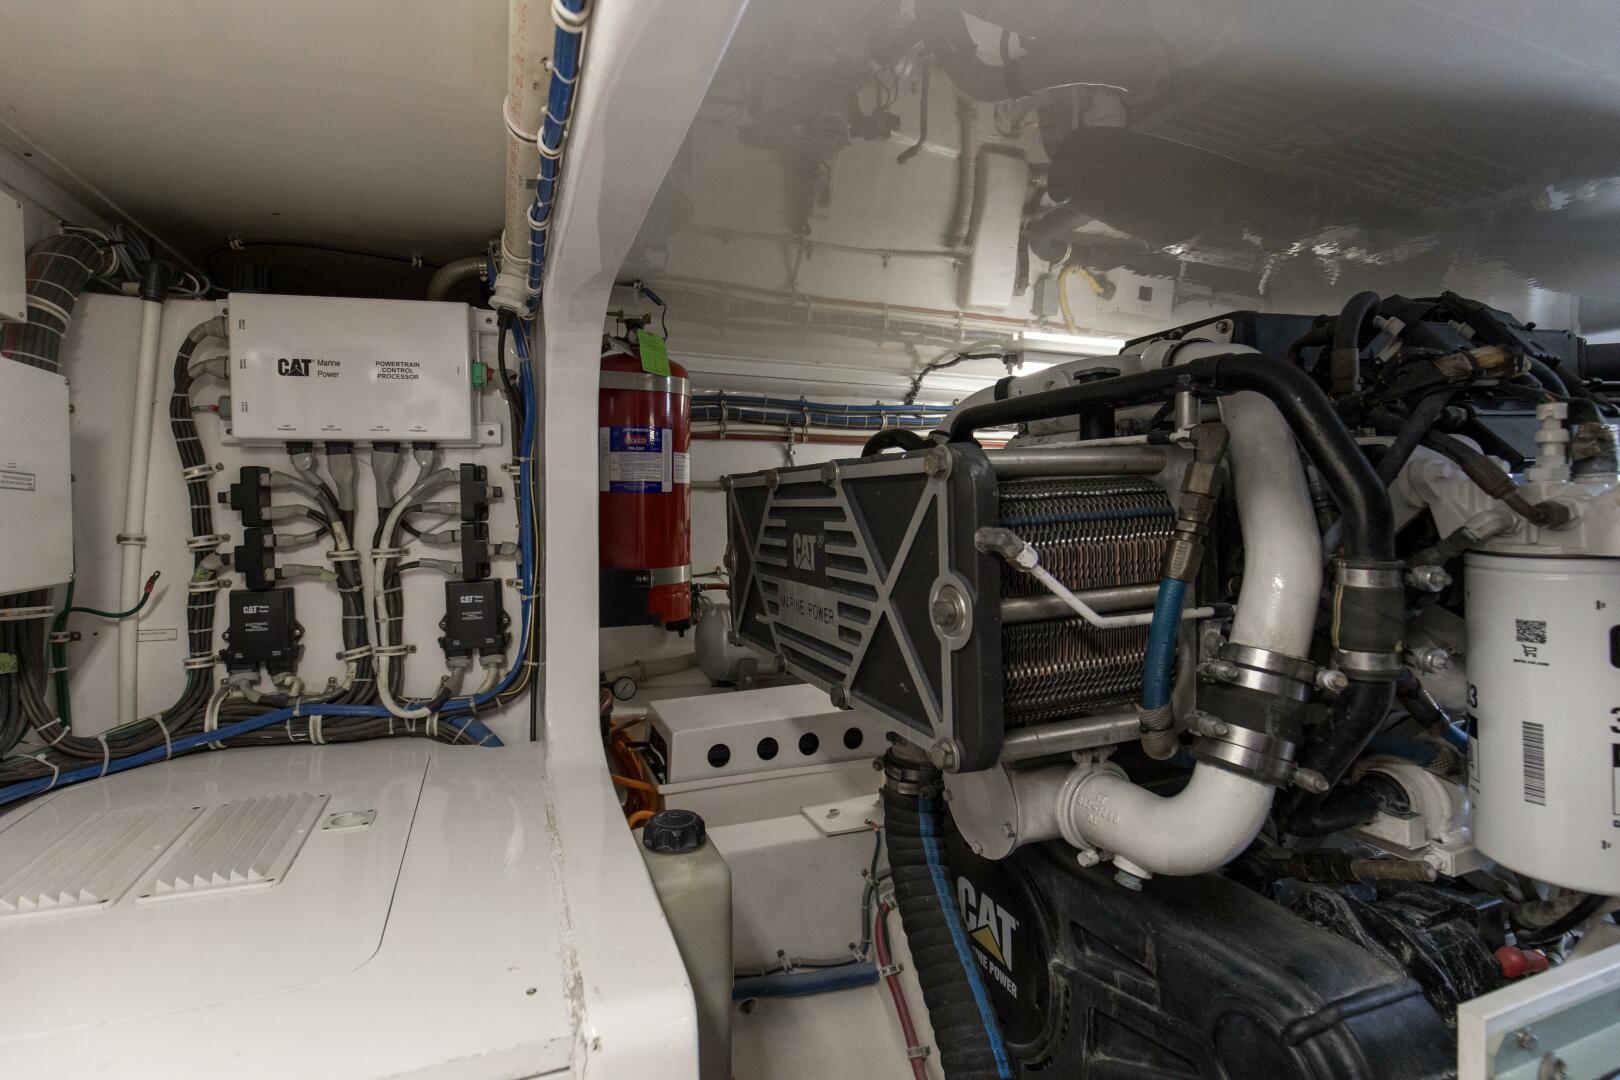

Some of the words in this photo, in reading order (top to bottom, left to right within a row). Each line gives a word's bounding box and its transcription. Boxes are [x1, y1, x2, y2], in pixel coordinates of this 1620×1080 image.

[277, 358, 312, 377] CAT
[317, 359, 341, 367] Marine
[375, 360, 420, 368] POWERTRAIN
[317, 370, 339, 378] Power
[460, 595, 473, 604] CAT
[243, 605, 258, 614] CAT
[781, 592, 804, 616] MARINE
[808, 602, 834, 625] POWER
[957, 876, 1017, 972] CAT
[989, 960, 1018, 999] POWER
